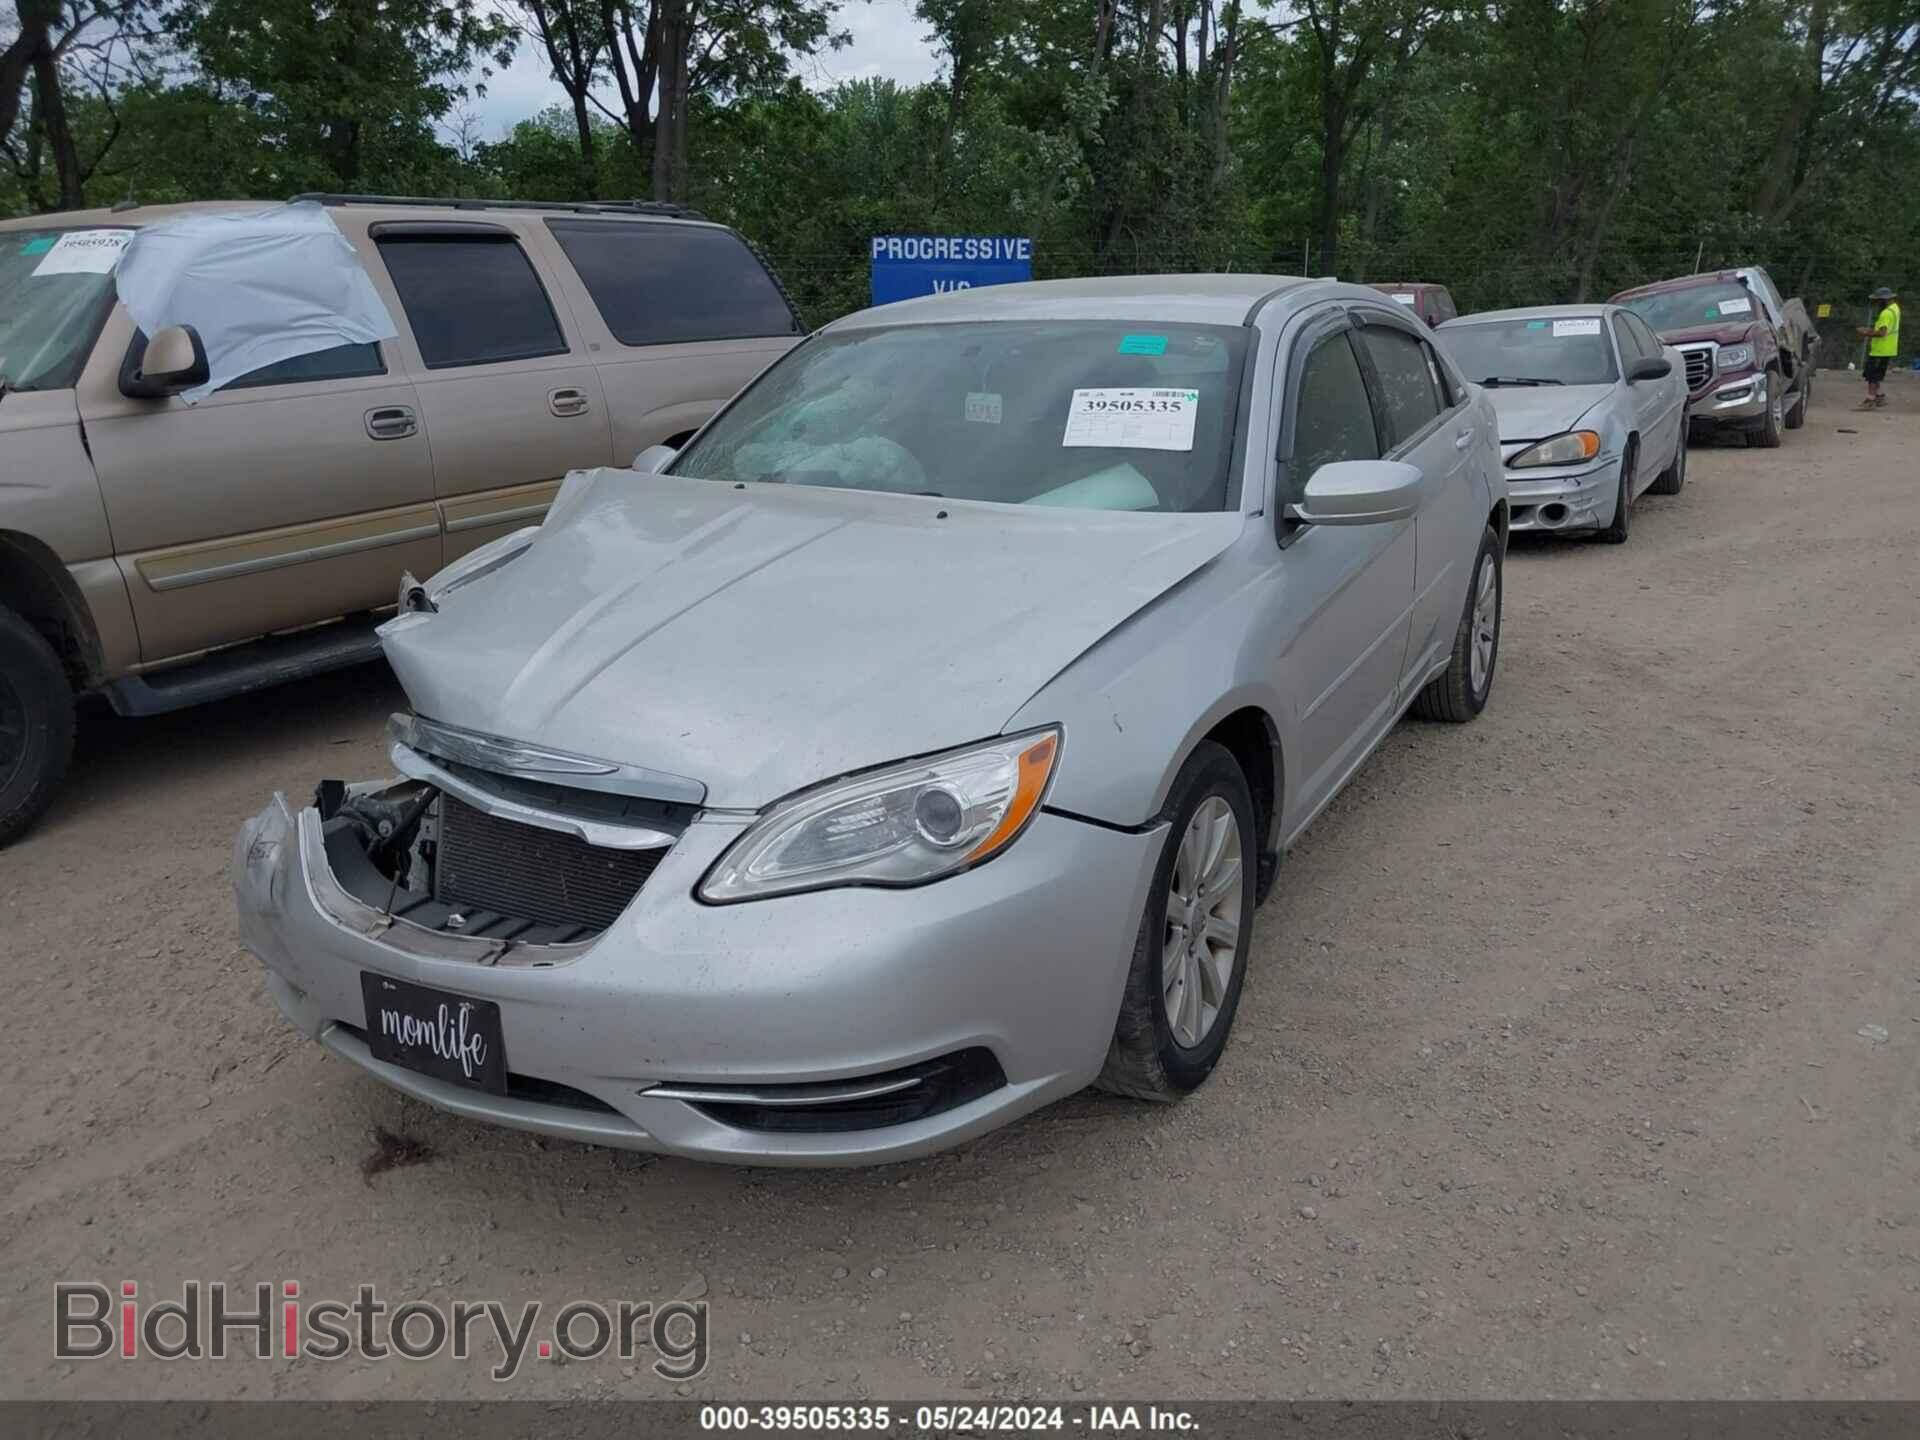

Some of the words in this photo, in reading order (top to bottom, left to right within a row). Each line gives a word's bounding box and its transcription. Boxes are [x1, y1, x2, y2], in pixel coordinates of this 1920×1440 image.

[872, 238, 1031, 260] PROGRESSIVE
[1082, 401, 1182, 413] 39505335
[381, 1004, 487, 1078] momlife
